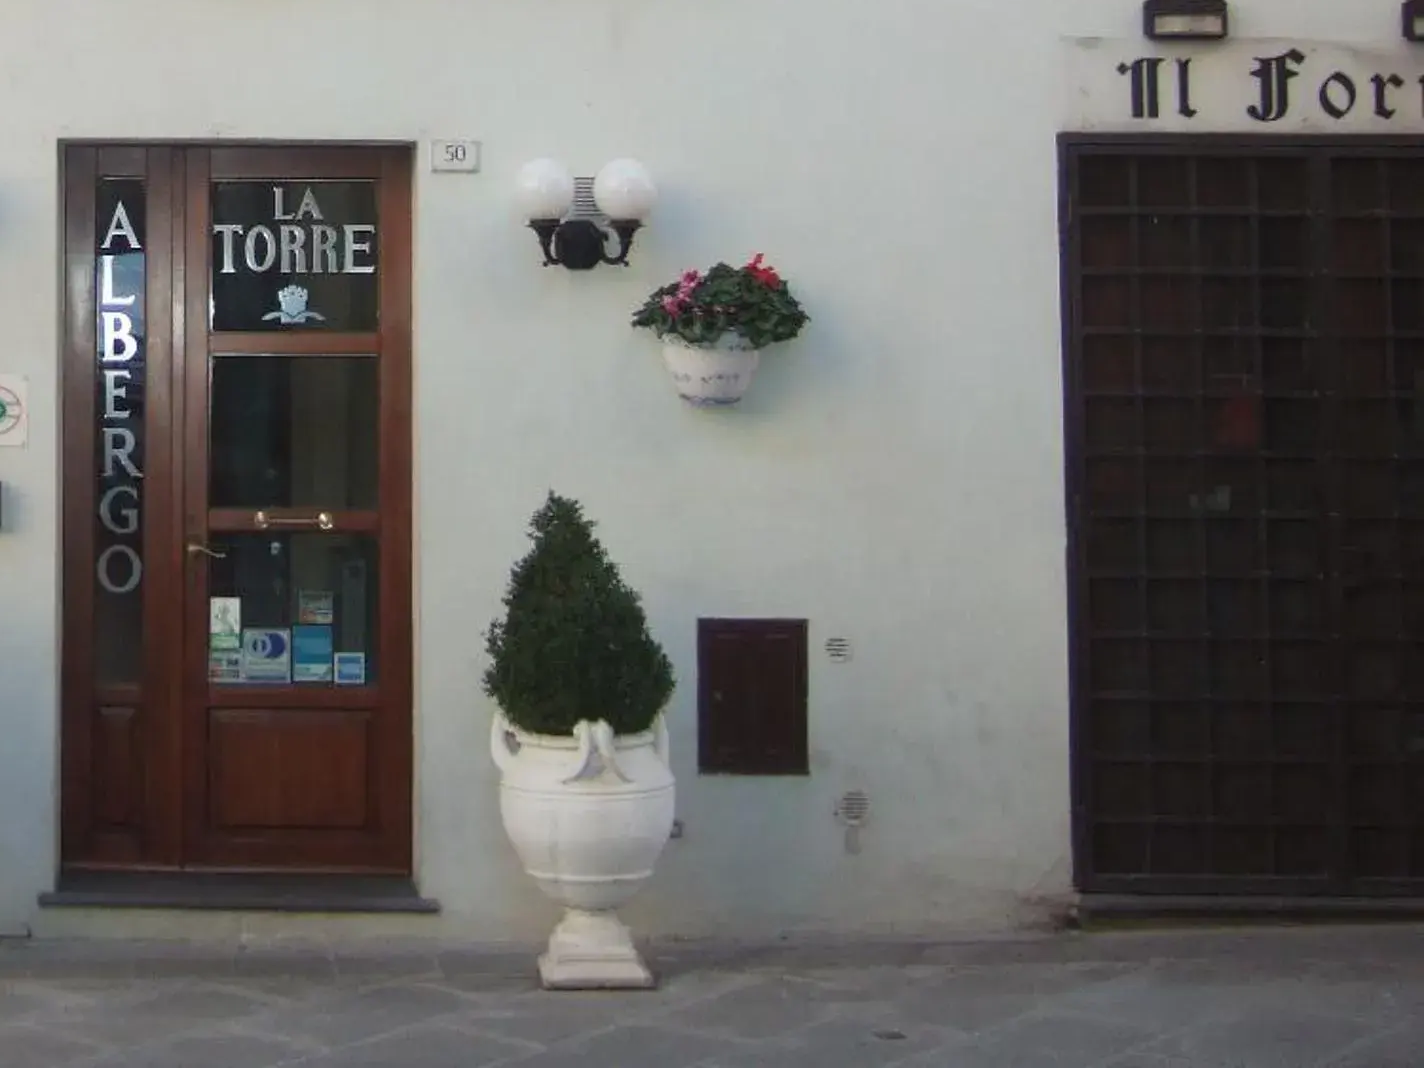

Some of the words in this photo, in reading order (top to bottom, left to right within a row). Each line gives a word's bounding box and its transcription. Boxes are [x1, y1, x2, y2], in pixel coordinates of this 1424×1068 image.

[1247, 48, 1424, 122] For
[444, 144, 466, 162] 50
[273, 186, 324, 221] LA
[213, 224, 376, 274] TORRE
[97, 200, 144, 593] ALBERGO
